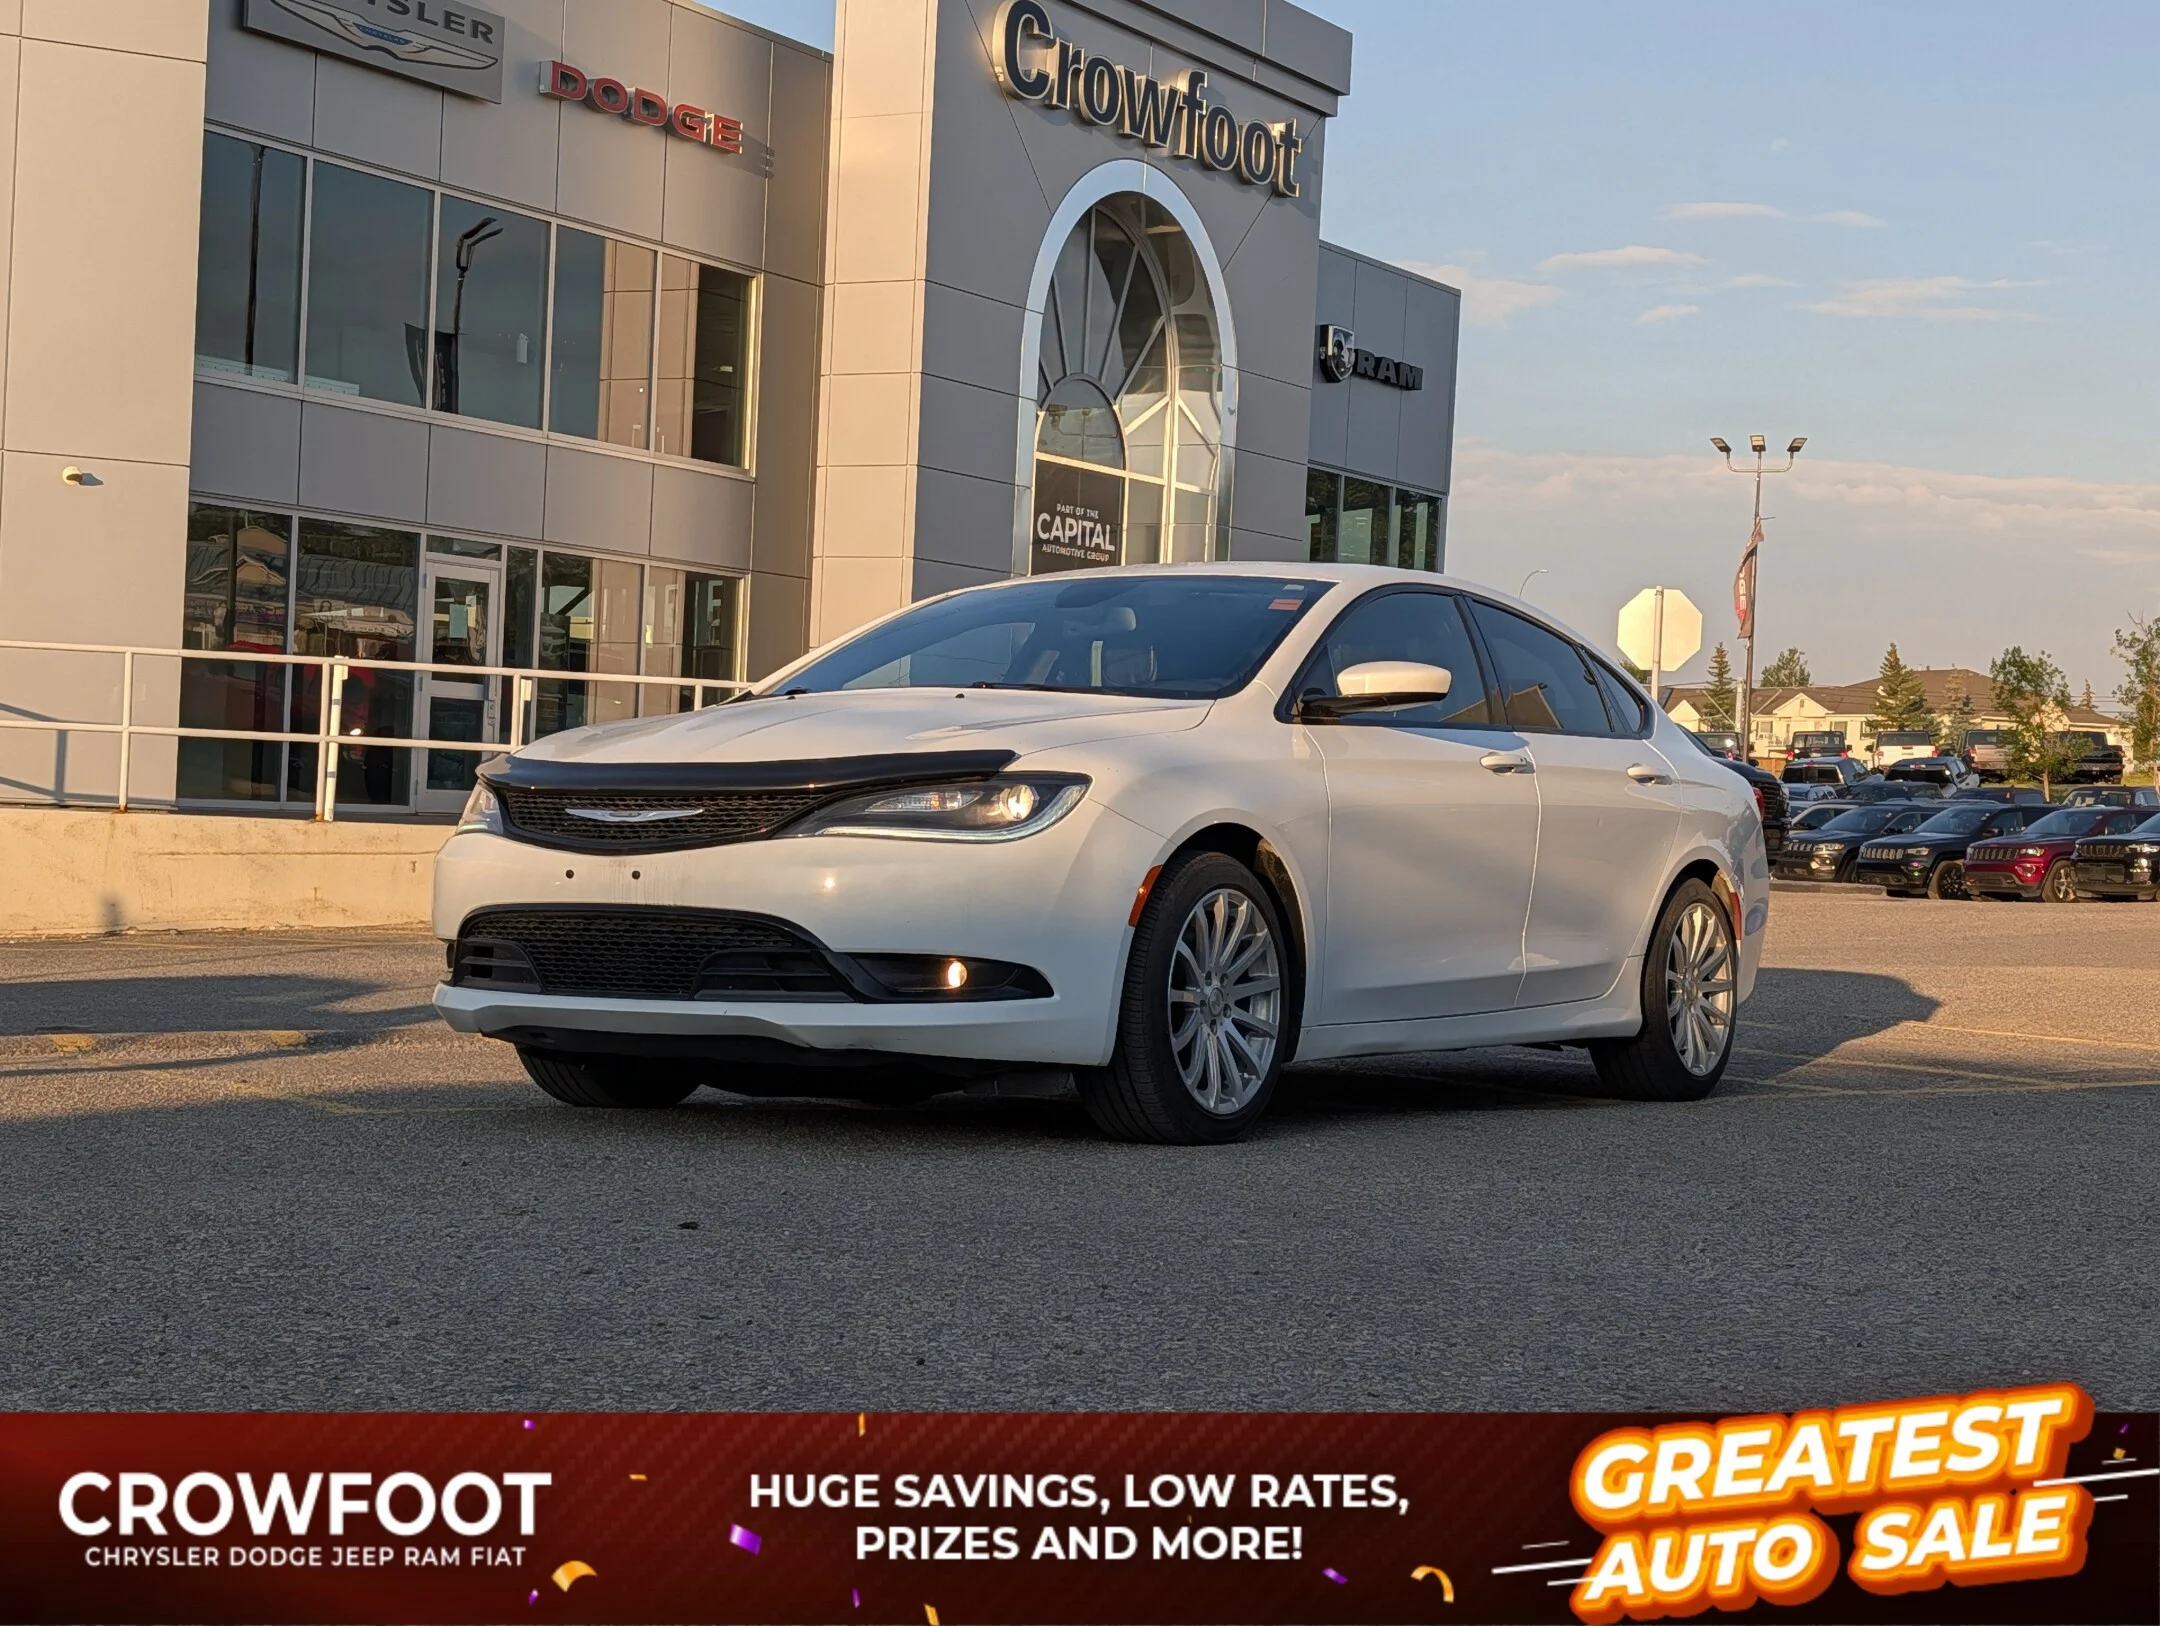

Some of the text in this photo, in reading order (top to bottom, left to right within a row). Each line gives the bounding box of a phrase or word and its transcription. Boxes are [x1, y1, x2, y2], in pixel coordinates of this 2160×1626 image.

[551, 60, 744, 154] DODGE
[992, 0, 1301, 197] Crowfoot
[1355, 348, 1424, 391] RAM
[1037, 512, 1115, 551] CAPITAL
[1056, 503, 1099, 519] PART OF THE
[1041, 543, 1110, 562] AUTOMOTIVE GROUP
